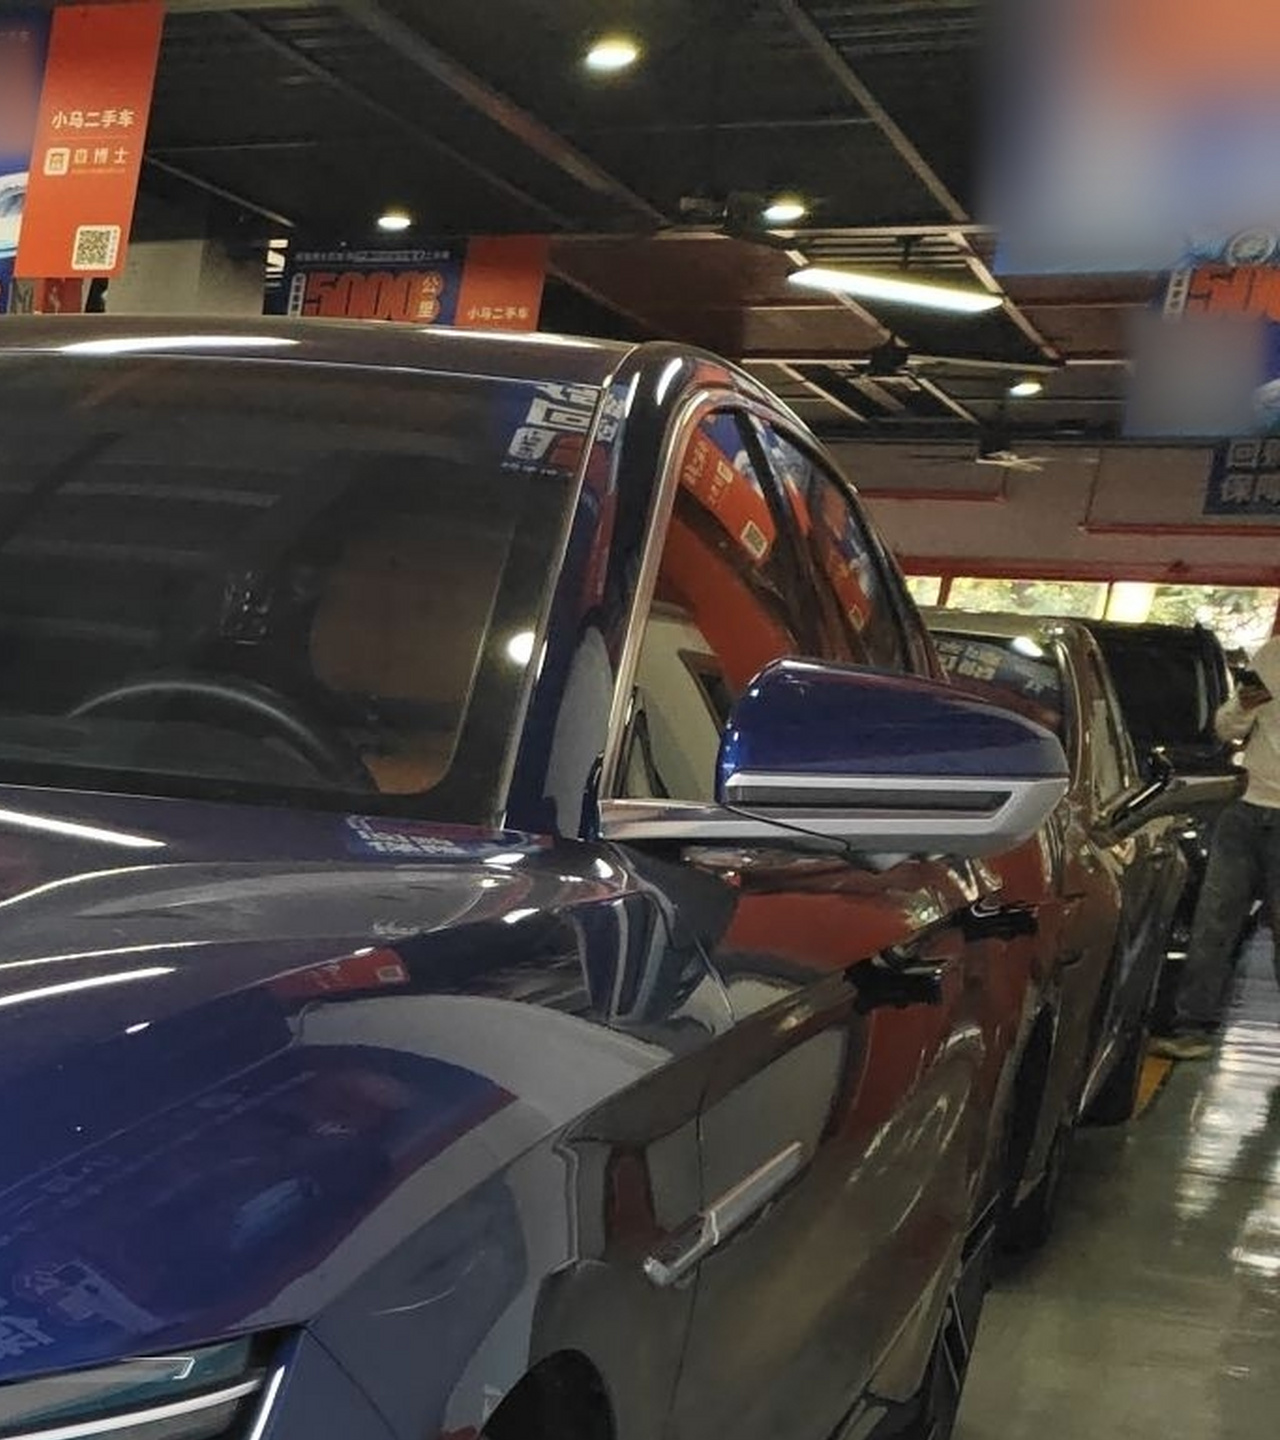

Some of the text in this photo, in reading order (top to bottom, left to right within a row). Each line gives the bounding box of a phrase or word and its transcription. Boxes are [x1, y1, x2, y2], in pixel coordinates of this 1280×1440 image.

[51, 109, 135, 129] 小马二手车
